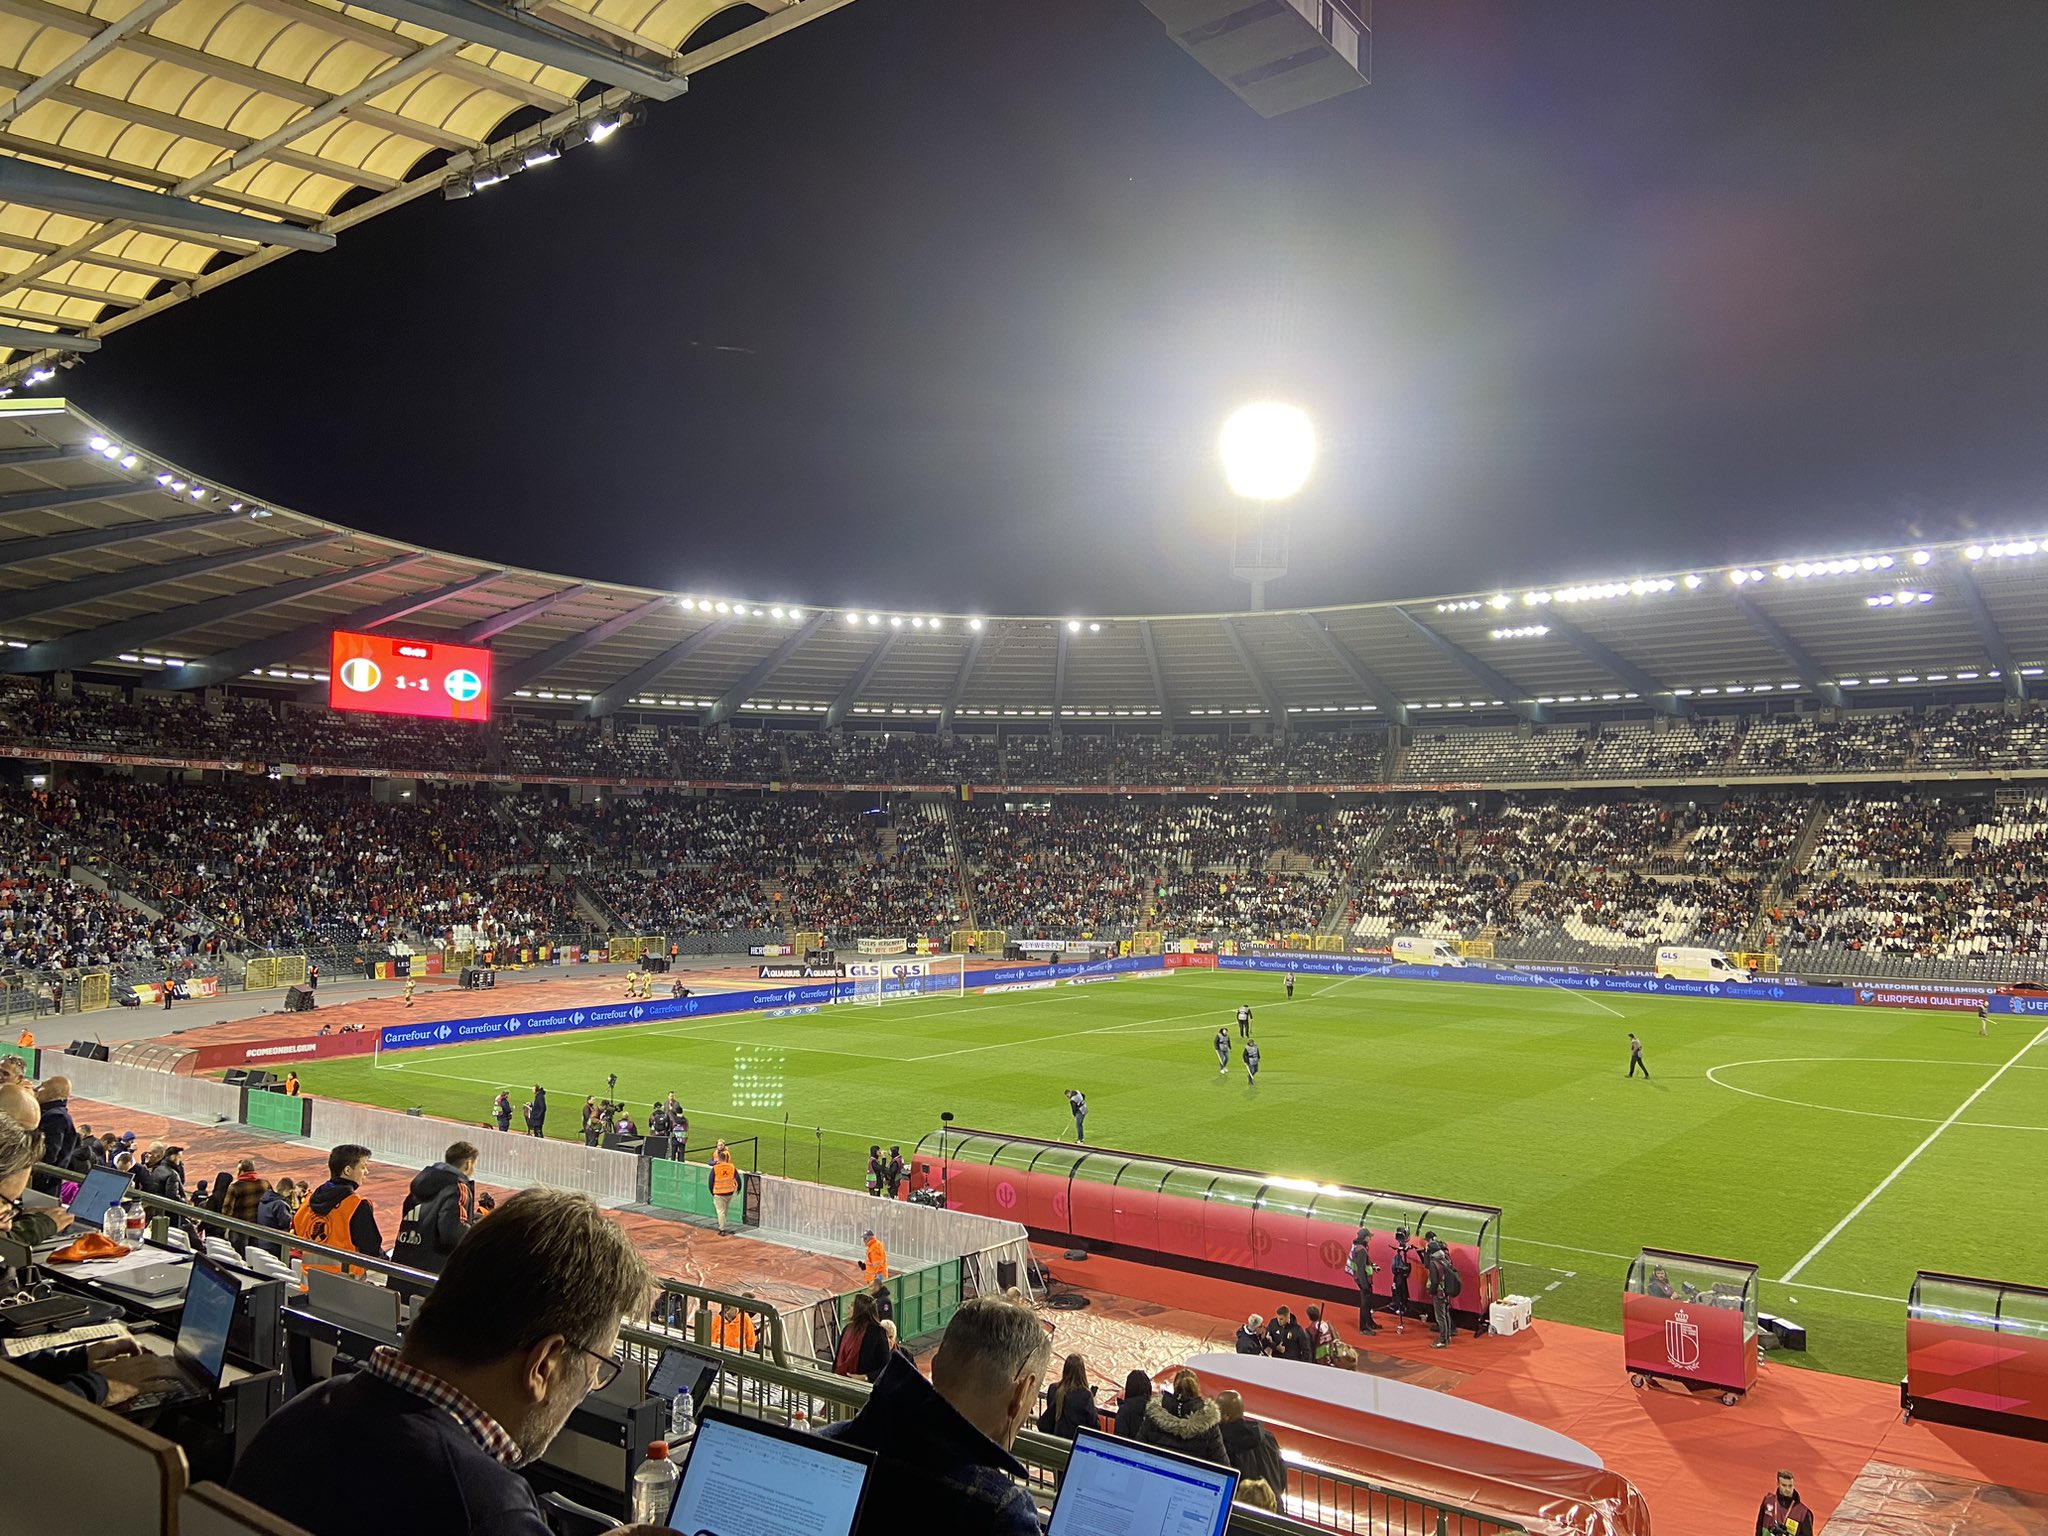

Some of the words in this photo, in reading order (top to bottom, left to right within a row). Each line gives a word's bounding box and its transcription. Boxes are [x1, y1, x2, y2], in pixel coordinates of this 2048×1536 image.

[1398, 941, 1412, 949] GLS
[750, 946, 791, 955] HERATH
[1661, 952, 1677, 960] GLS
[1219, 958, 1244, 966] Carrefour
[1260, 960, 1286, 969] Carrefour
[1303, 963, 1331, 971] Carrefour
[803, 967, 844, 978] AQUARIS
[850, 965, 879, 976] GLS
[892, 964, 921, 976] GLS
[1027, 970, 1046, 978] Carrefour
[1495, 973, 1529, 982] Carrefour
[1549, 976, 1584, 985] Carrefour
[1605, 979, 1641, 989] Carrefour
[1664, 982, 1702, 992] Carrefour
[1864, 982, 1919, 991] PLATEFORME
[1933, 986, 1985, 994] STREAMING
[800, 989, 829, 999] Carrefour
[1726, 986, 1766, 996] Carrefour
[753, 993, 783, 1004] Carrefour
[1877, 994, 1928, 1004] EUROPEAN
[1930, 996, 1984, 1007] QUALIFIERS
[650, 1004, 683, 1015] Carrefour
[591, 1010, 627, 1021] Carrefour
[528, 1015, 567, 1028] Carrefour
[459, 1022, 502, 1035] Carrefour
[385, 1030, 432, 1044] Carrefour
[245, 1043, 317, 1058] #COMEONBELGIUM
